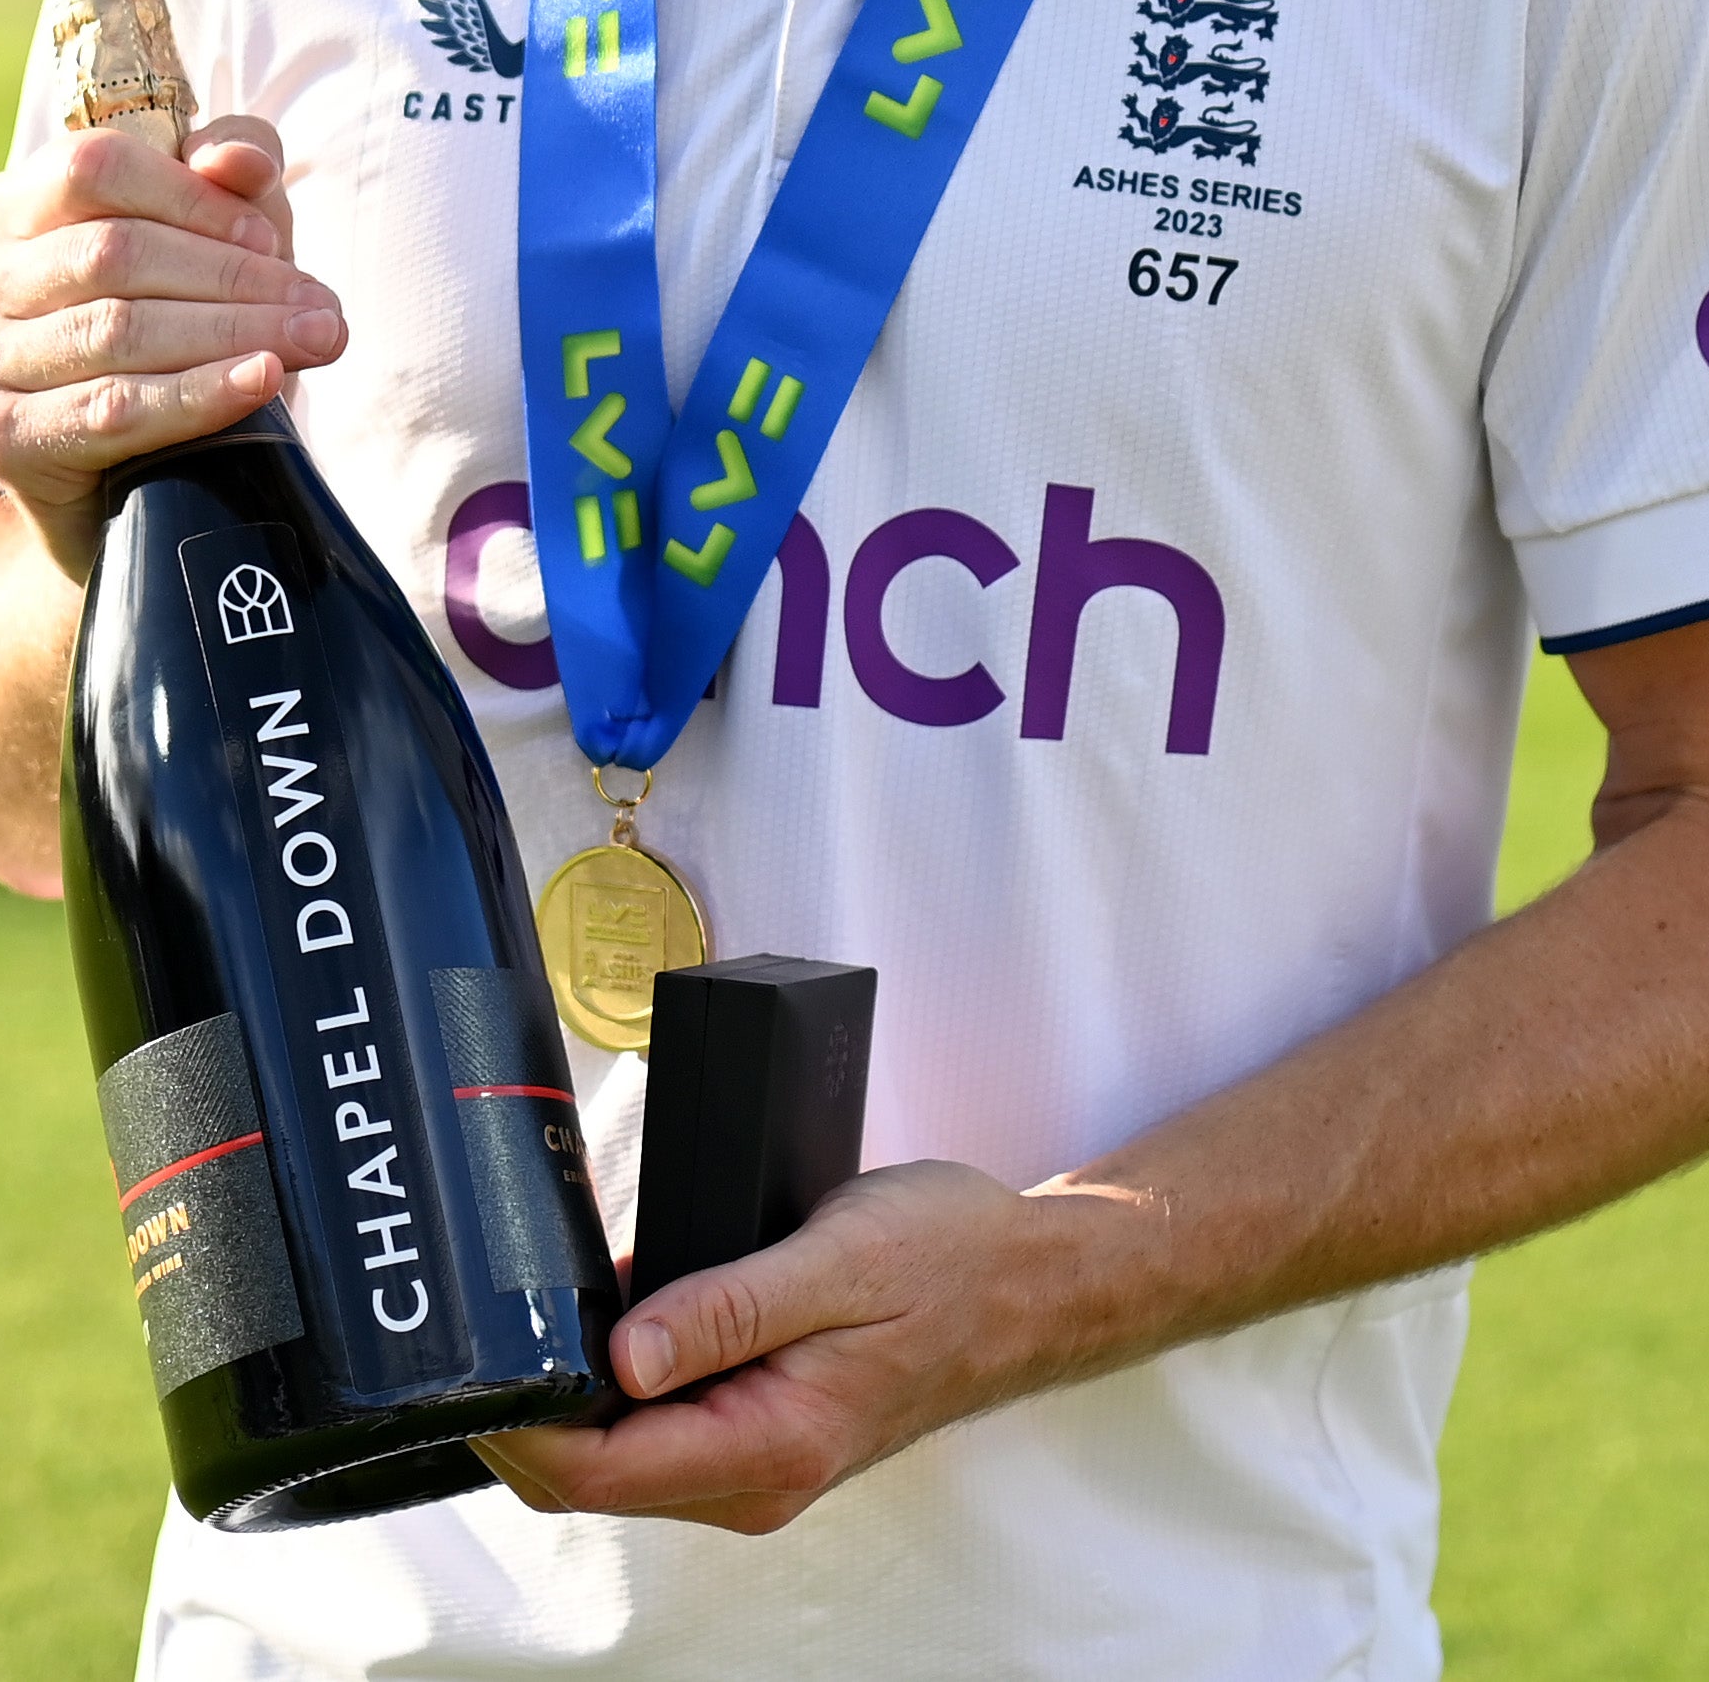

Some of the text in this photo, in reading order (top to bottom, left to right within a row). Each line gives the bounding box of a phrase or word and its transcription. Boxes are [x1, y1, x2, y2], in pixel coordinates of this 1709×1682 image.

[403, 89, 517, 123] CAST
[1073, 165, 1302, 217] ASHES SERIES
[1154, 207, 1223, 239] 2023
[1128, 248, 1240, 306] 657
[444, 480, 1226, 756] cnch
[248, 686, 431, 1335] CHAPEL DOWN
[127, 1201, 191, 1266] DOWN
